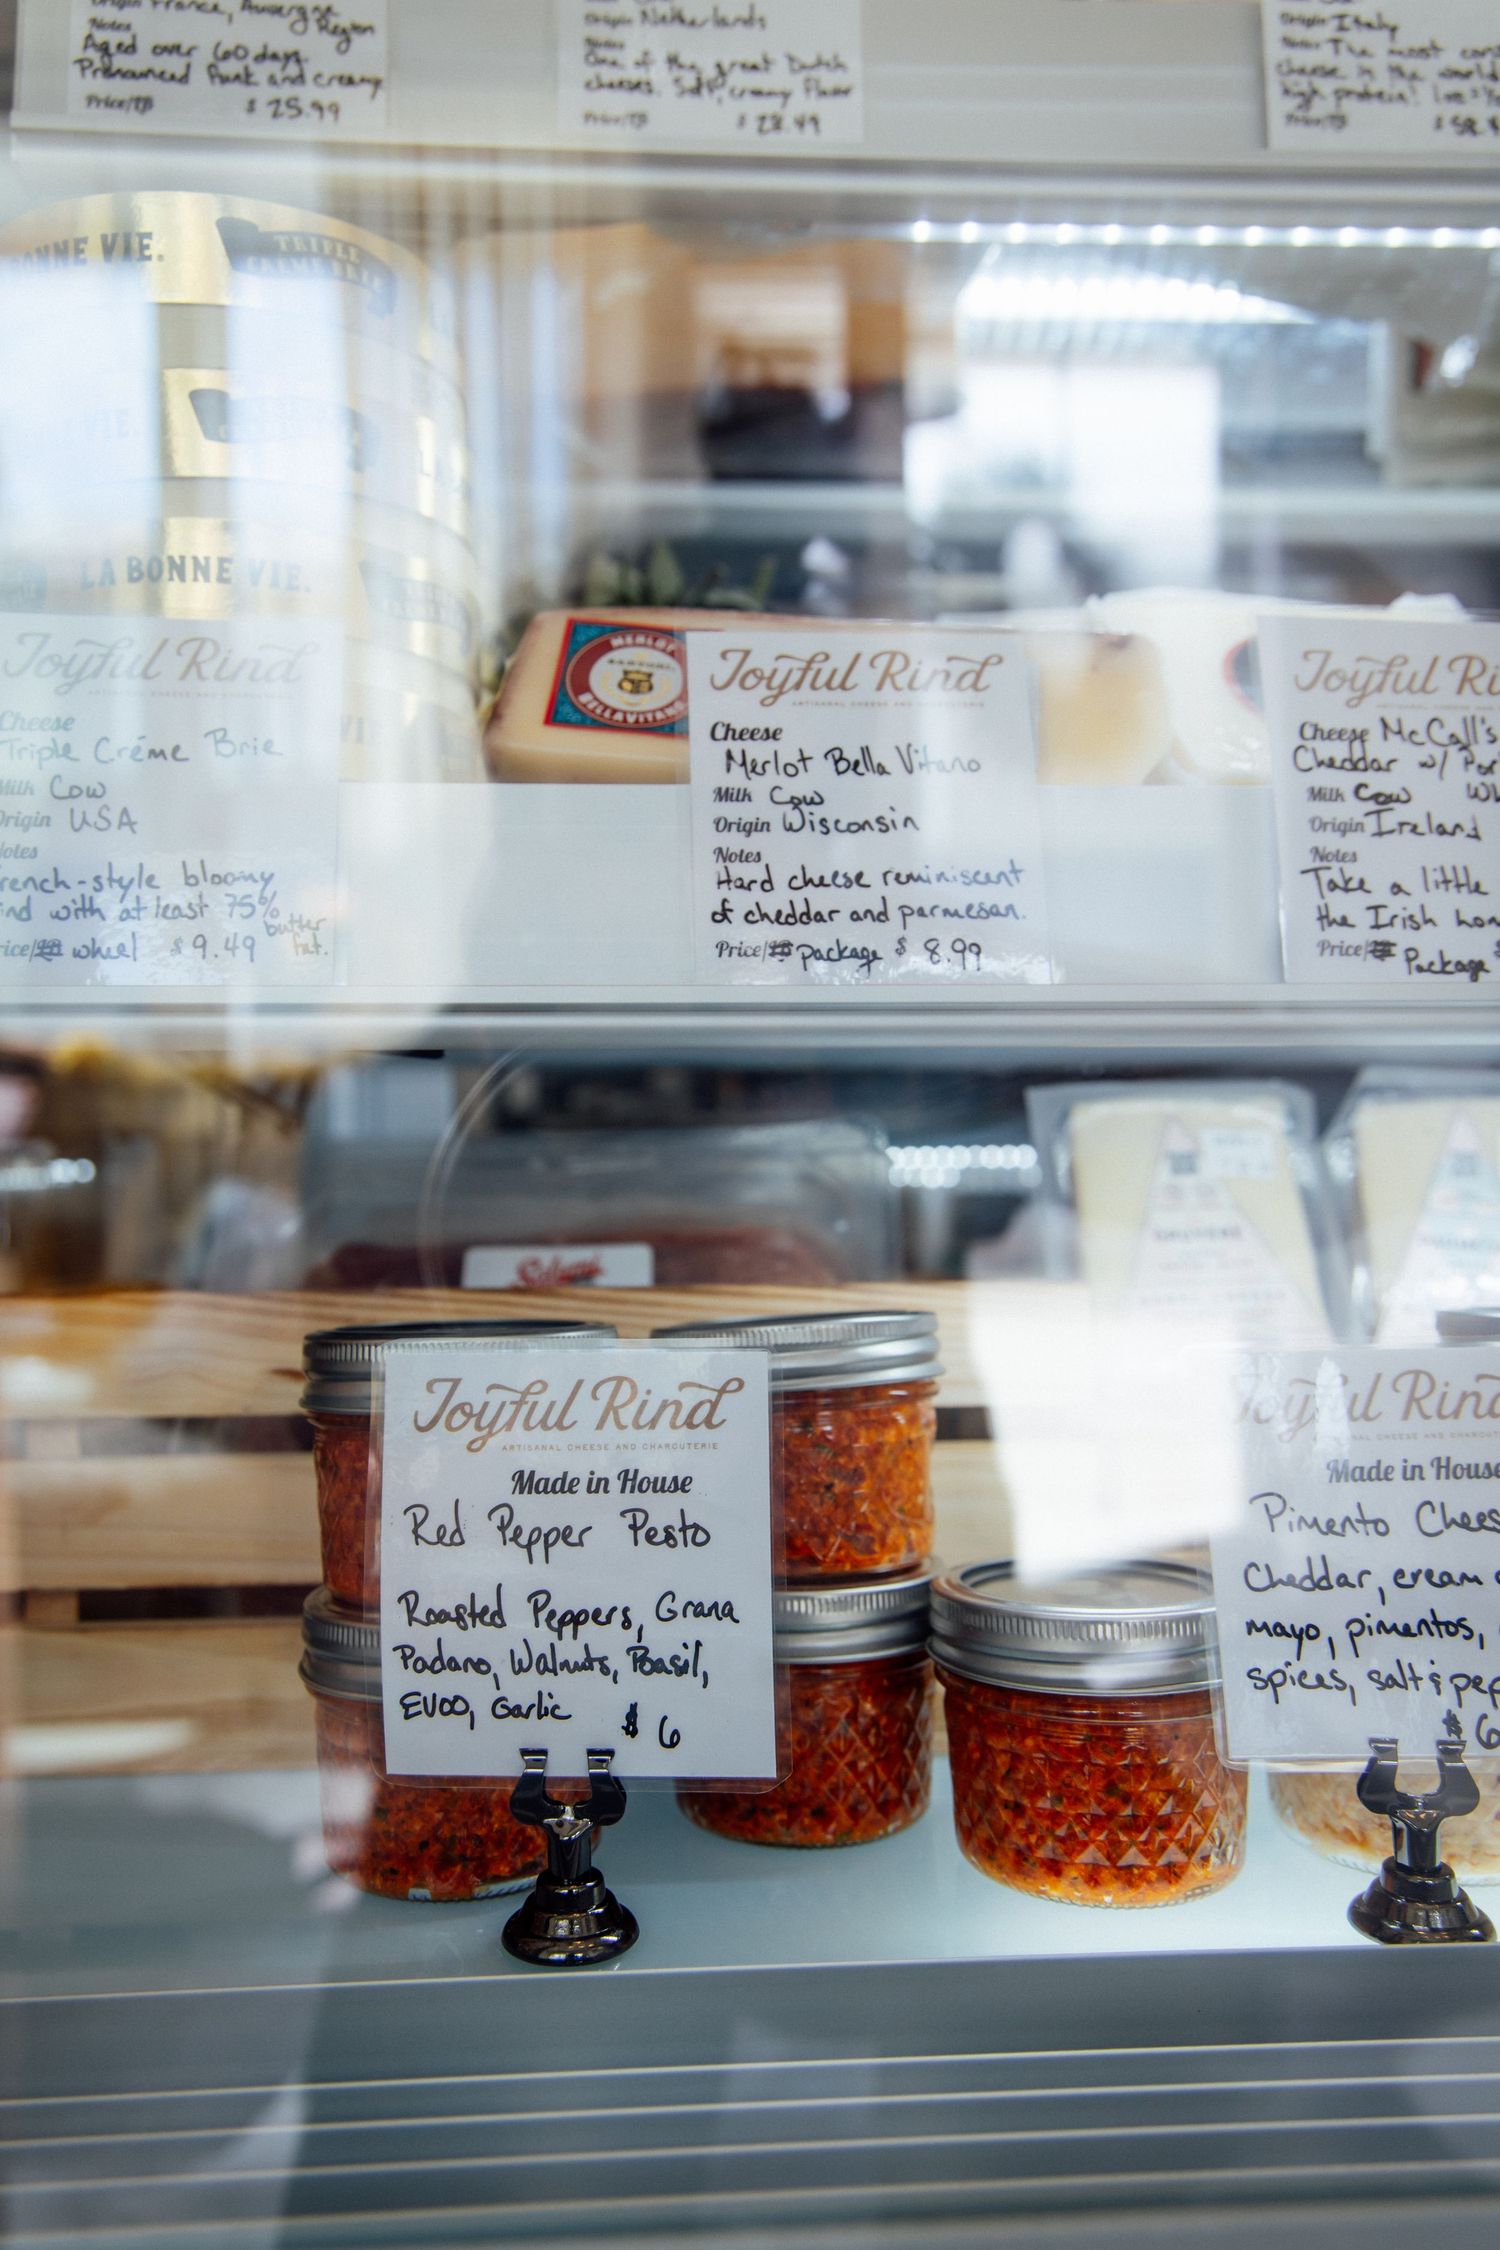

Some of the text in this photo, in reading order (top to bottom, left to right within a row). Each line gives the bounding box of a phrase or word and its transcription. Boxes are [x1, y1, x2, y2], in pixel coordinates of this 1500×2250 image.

[83, 33, 138, 60] Aged
[152, 43, 198, 58] over
[213, 41, 249, 62] 60
[268, 64, 306, 87] and
[11, 231, 165, 270] ONNE VIE.
[127, 554, 233, 585] BONNE
[3, 632, 321, 696] Joyful Rind
[709, 648, 1004, 708] Joyful Rind
[1295, 649, 1441, 708] Joyful
[0, 710, 75, 732] Cheese
[709, 721, 783, 742] Cheese
[1299, 721, 1369, 743] Cheese
[0, 736, 81, 770] Triple
[203, 727, 283, 759] Brie
[725, 743, 982, 781] Merlot Bella Vitano
[1292, 735, 1398, 772] Cheddar
[50, 774, 107, 801] Cow
[712, 785, 825, 806] Milk Cow
[1306, 783, 1413, 806] Milk Cow
[69, 803, 138, 834] USA
[712, 806, 920, 838] Origin Wisconsin
[1308, 807, 1483, 841] Origin Ireland
[712, 847, 762, 864] Notes
[1309, 846, 1358, 864] Notes
[0, 860, 161, 903] rench-style
[716, 859, 1025, 893] Hard cheese reminiscent
[1300, 865, 1489, 900] Take a little
[50, 893, 107, 922] with
[154, 890, 211, 921] least
[711, 898, 734, 925] of
[744, 898, 841, 926] cheddar
[849, 896, 890, 925] and
[1316, 902, 1438, 932] the Irish
[72, 931, 138, 962] wheel
[796, 938, 884, 978] package
[413, 1374, 745, 1454] Joyful Rind
[1236, 1372, 1383, 1443] oyul
[501, 1441, 720, 1452] ARTISANAL CHEESE AND CHARCUTERIE
[511, 1468, 694, 1495] Made in House
[1326, 1458, 1395, 1484] Made
[1401, 1458, 1426, 1482] in
[403, 1498, 712, 1565] Red Pepper Pesto
[1249, 1491, 1391, 1538] Pimento
[1243, 1554, 1386, 1606] Cheddar,
[396, 1582, 741, 1643] Roasted Peppers, Grana
[1245, 1607, 1485, 1662] mayo, pimentos,
[392, 1637, 710, 1691] Padano, Walnuts, Basil,
[1246, 1660, 1357, 1707] spices,
[1366, 1658, 1424, 1692] salt
[398, 1690, 476, 1731] EVOO,
[490, 1690, 573, 1721] Garlic
